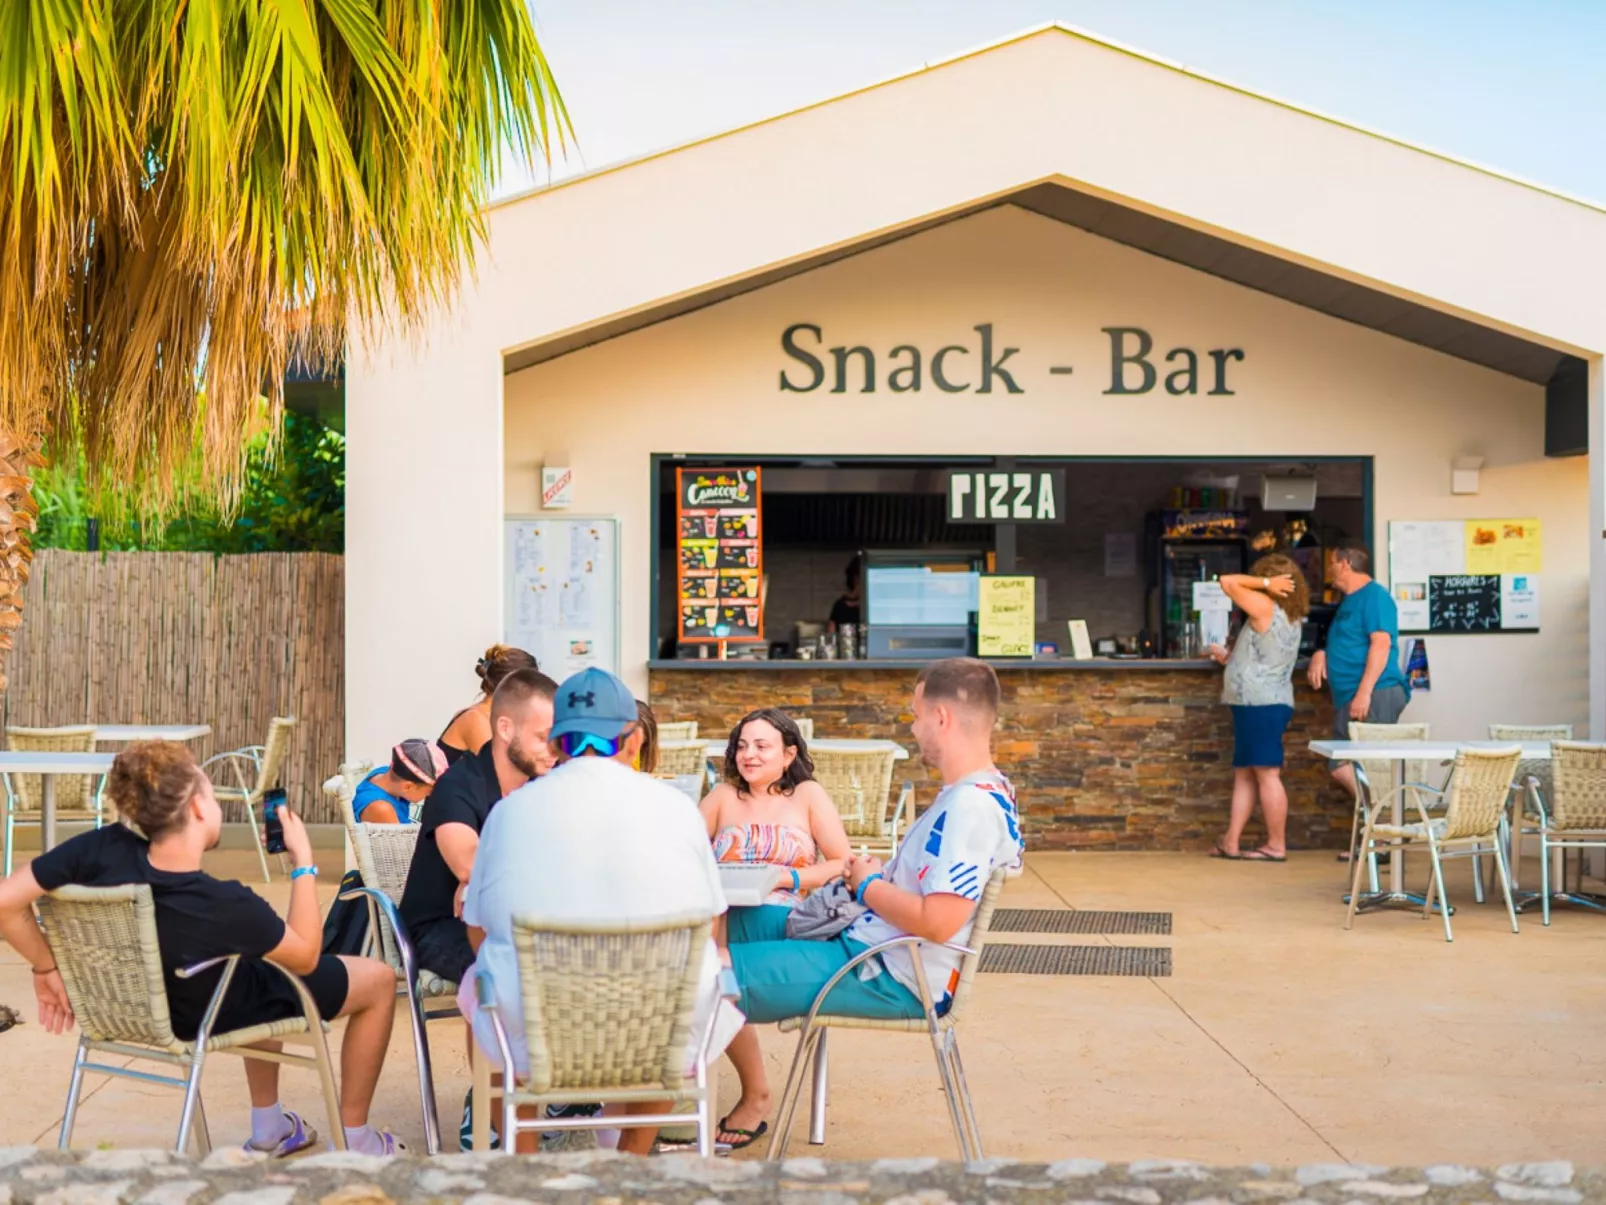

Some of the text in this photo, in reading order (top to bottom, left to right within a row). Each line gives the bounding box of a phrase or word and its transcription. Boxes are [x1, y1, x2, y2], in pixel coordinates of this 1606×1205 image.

[779, 322, 1245, 396] Snack - Bar
[951, 473, 1056, 519] PIZZA
